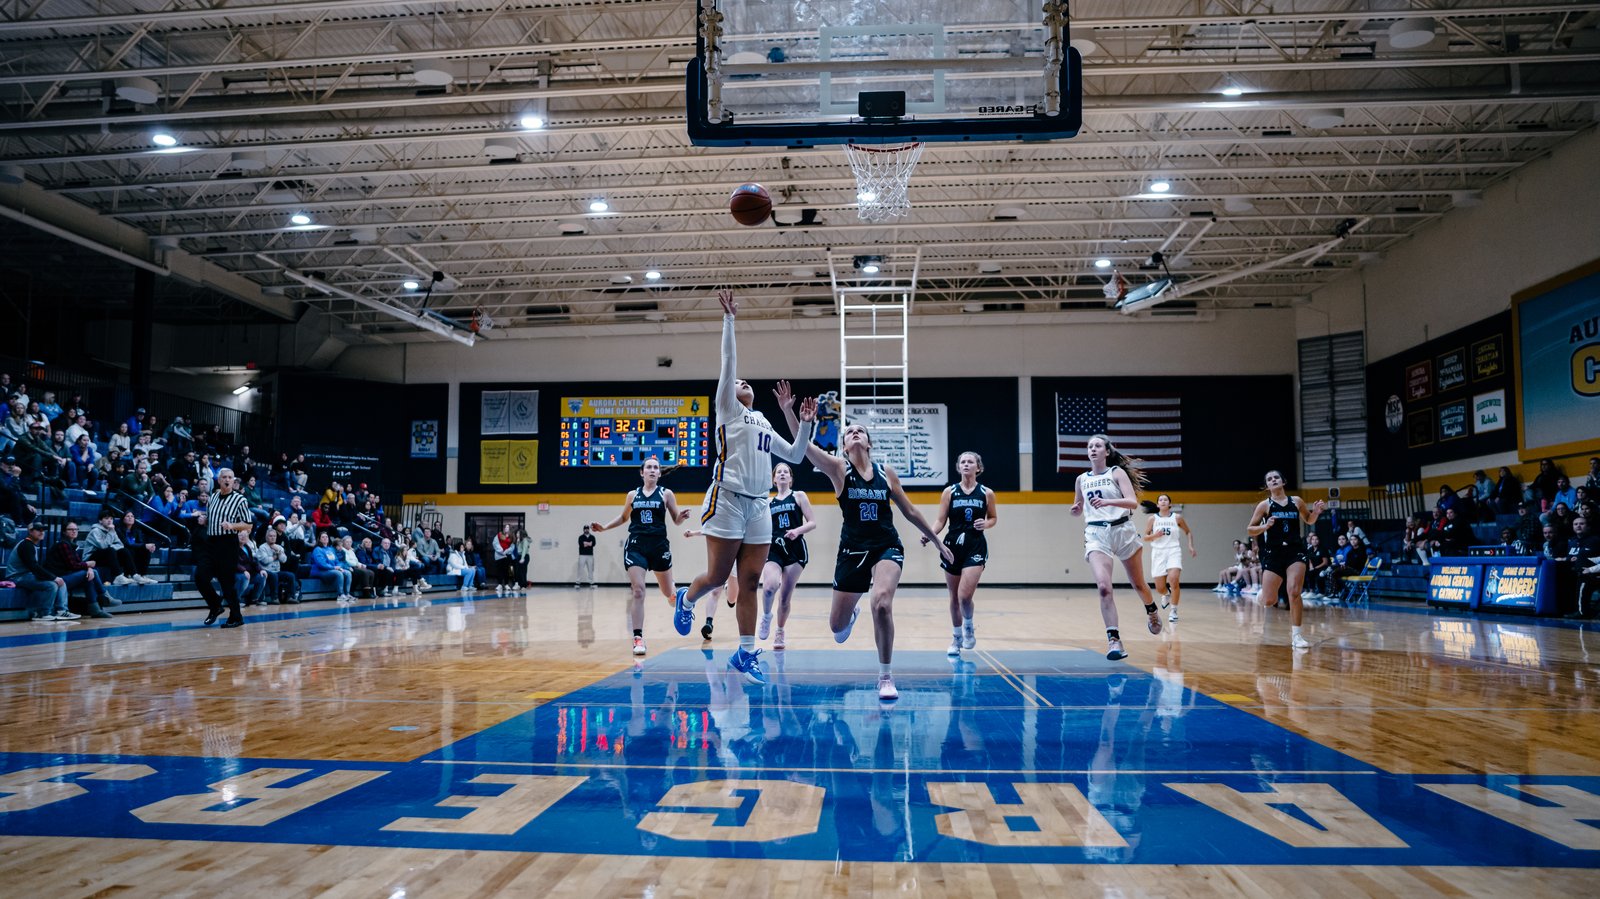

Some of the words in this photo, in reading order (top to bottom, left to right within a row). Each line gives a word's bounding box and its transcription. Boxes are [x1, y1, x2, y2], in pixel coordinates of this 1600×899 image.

[600, 427, 610, 438] 12
[668, 427, 674, 438] 4
[757, 431, 772, 453] 10
[598, 452, 604, 461] 4
[669, 451, 675, 461] 3
[848, 488, 887, 500] ROSARY
[953, 499, 983, 508] ROSARY
[640, 510, 653, 523] 12
[859, 502, 878, 521] 20
[965, 507, 973, 521] 2
[778, 513, 790, 528] 14
[1503, 567, 1518, 576] HOME
[1525, 567, 1536, 576] THE
[1498, 577, 1537, 595] CHARGERS
